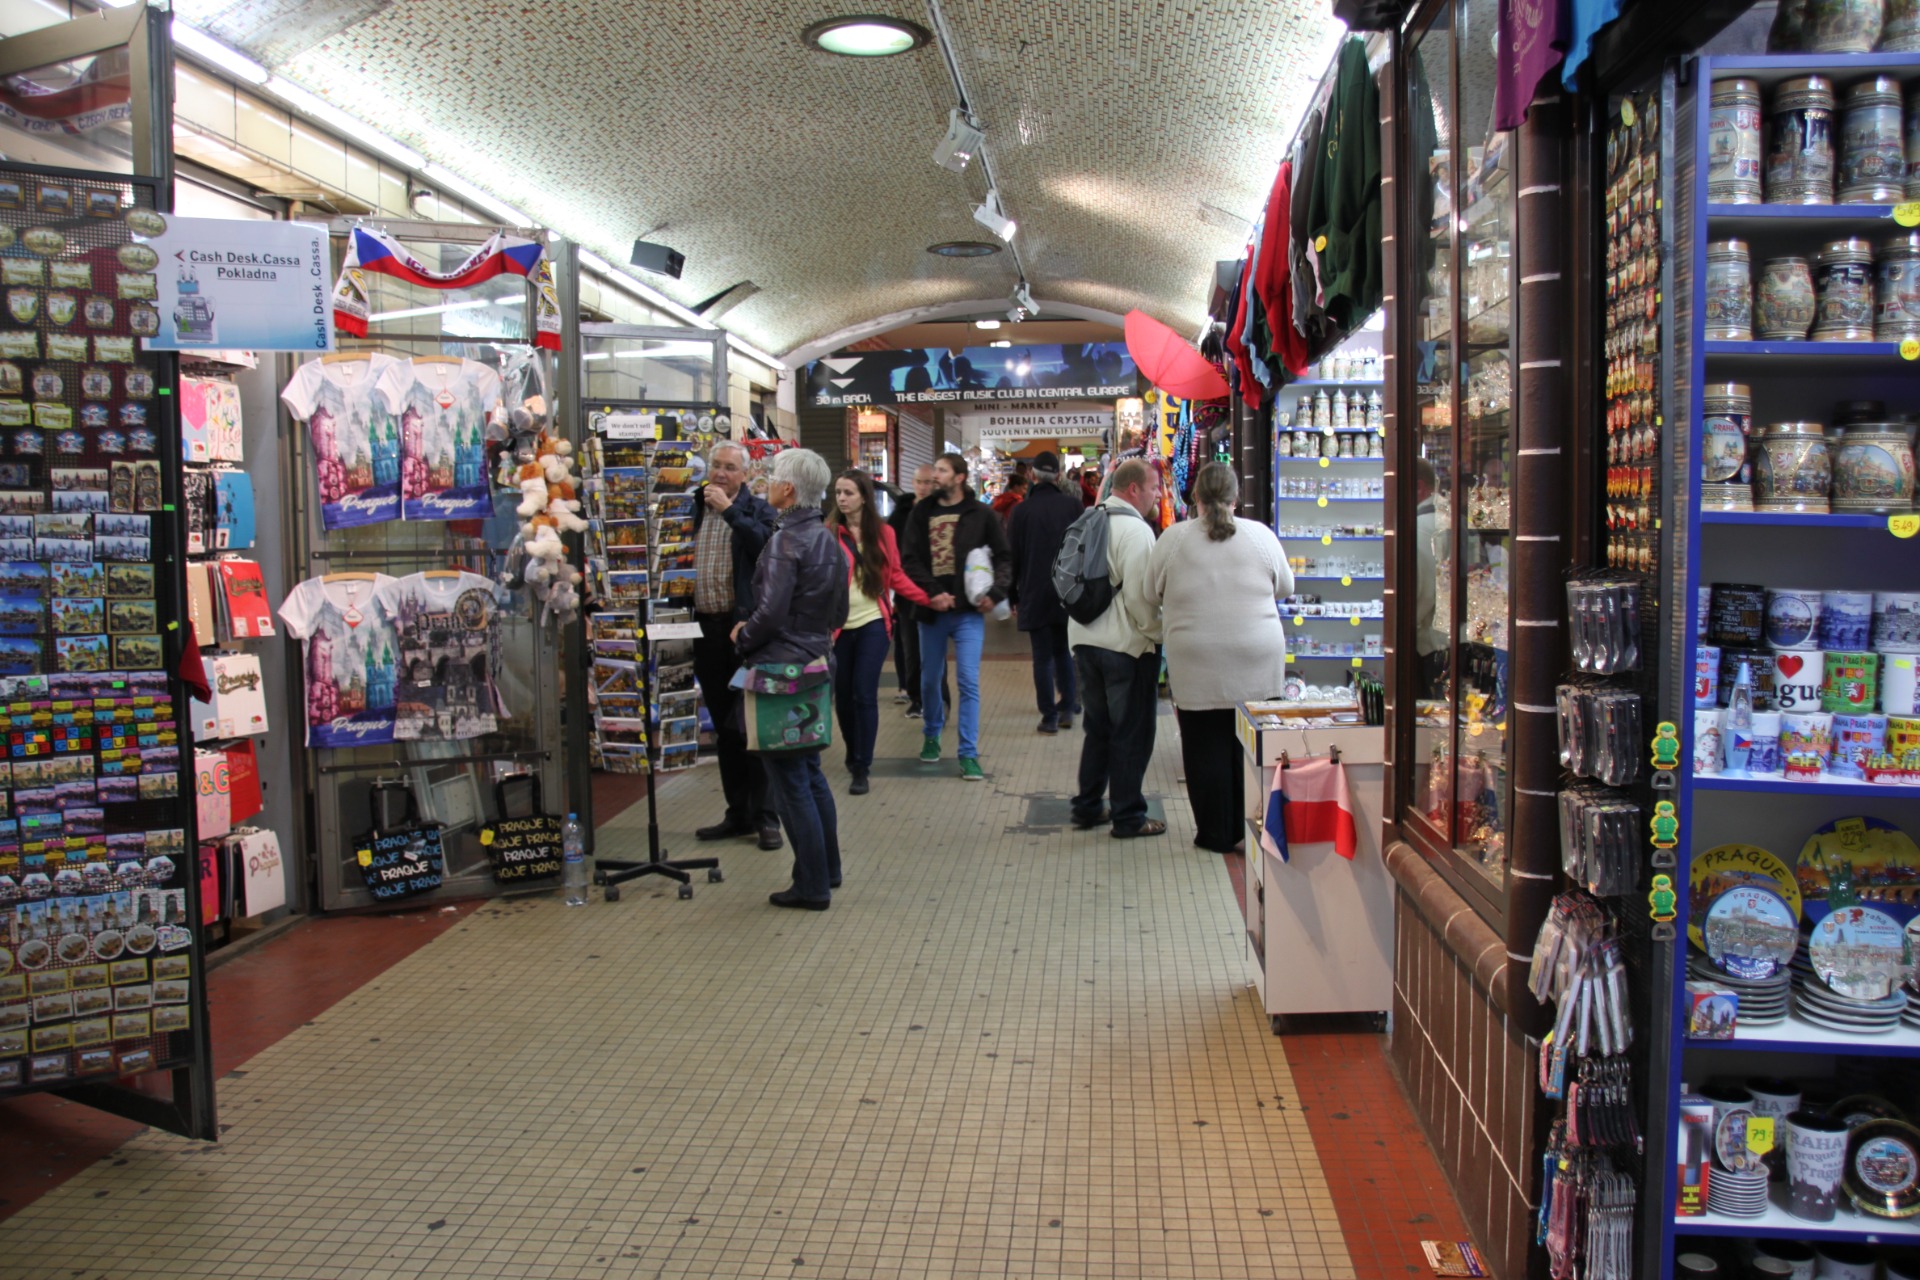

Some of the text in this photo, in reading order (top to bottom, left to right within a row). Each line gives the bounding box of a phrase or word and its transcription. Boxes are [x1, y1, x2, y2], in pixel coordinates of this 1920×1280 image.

[190, 250, 222, 263] Cash
[217, 267, 277, 280] Pokladna
[312, 285, 325, 315] Desk
[314, 318, 326, 349] Cash
[815, 395, 830, 405] 30
[843, 394, 872, 404] BACK
[895, 386, 1130, 402] THE BIGGEST MUSIC CLUB IN CENTRAL EUROPE
[974, 403, 1000, 411] MINI
[1011, 402, 1058, 410] MARKET
[990, 415, 1102, 425] BOHEMIA CRYSTAL
[982, 428, 1030, 436] SOUVENIR
[1033, 427, 1052, 435] AND
[340, 495, 399, 516] Prague
[422, 493, 477, 515] Prague
[332, 716, 391, 738] Prague
[499, 817, 544, 834] PRAGUE
[503, 846, 550, 863] PRAGUE
[380, 860, 429, 881] PRAGUE
[1703, 849, 1786, 881] PRAGUE
[1733, 892, 1773, 905] PRAGUE
